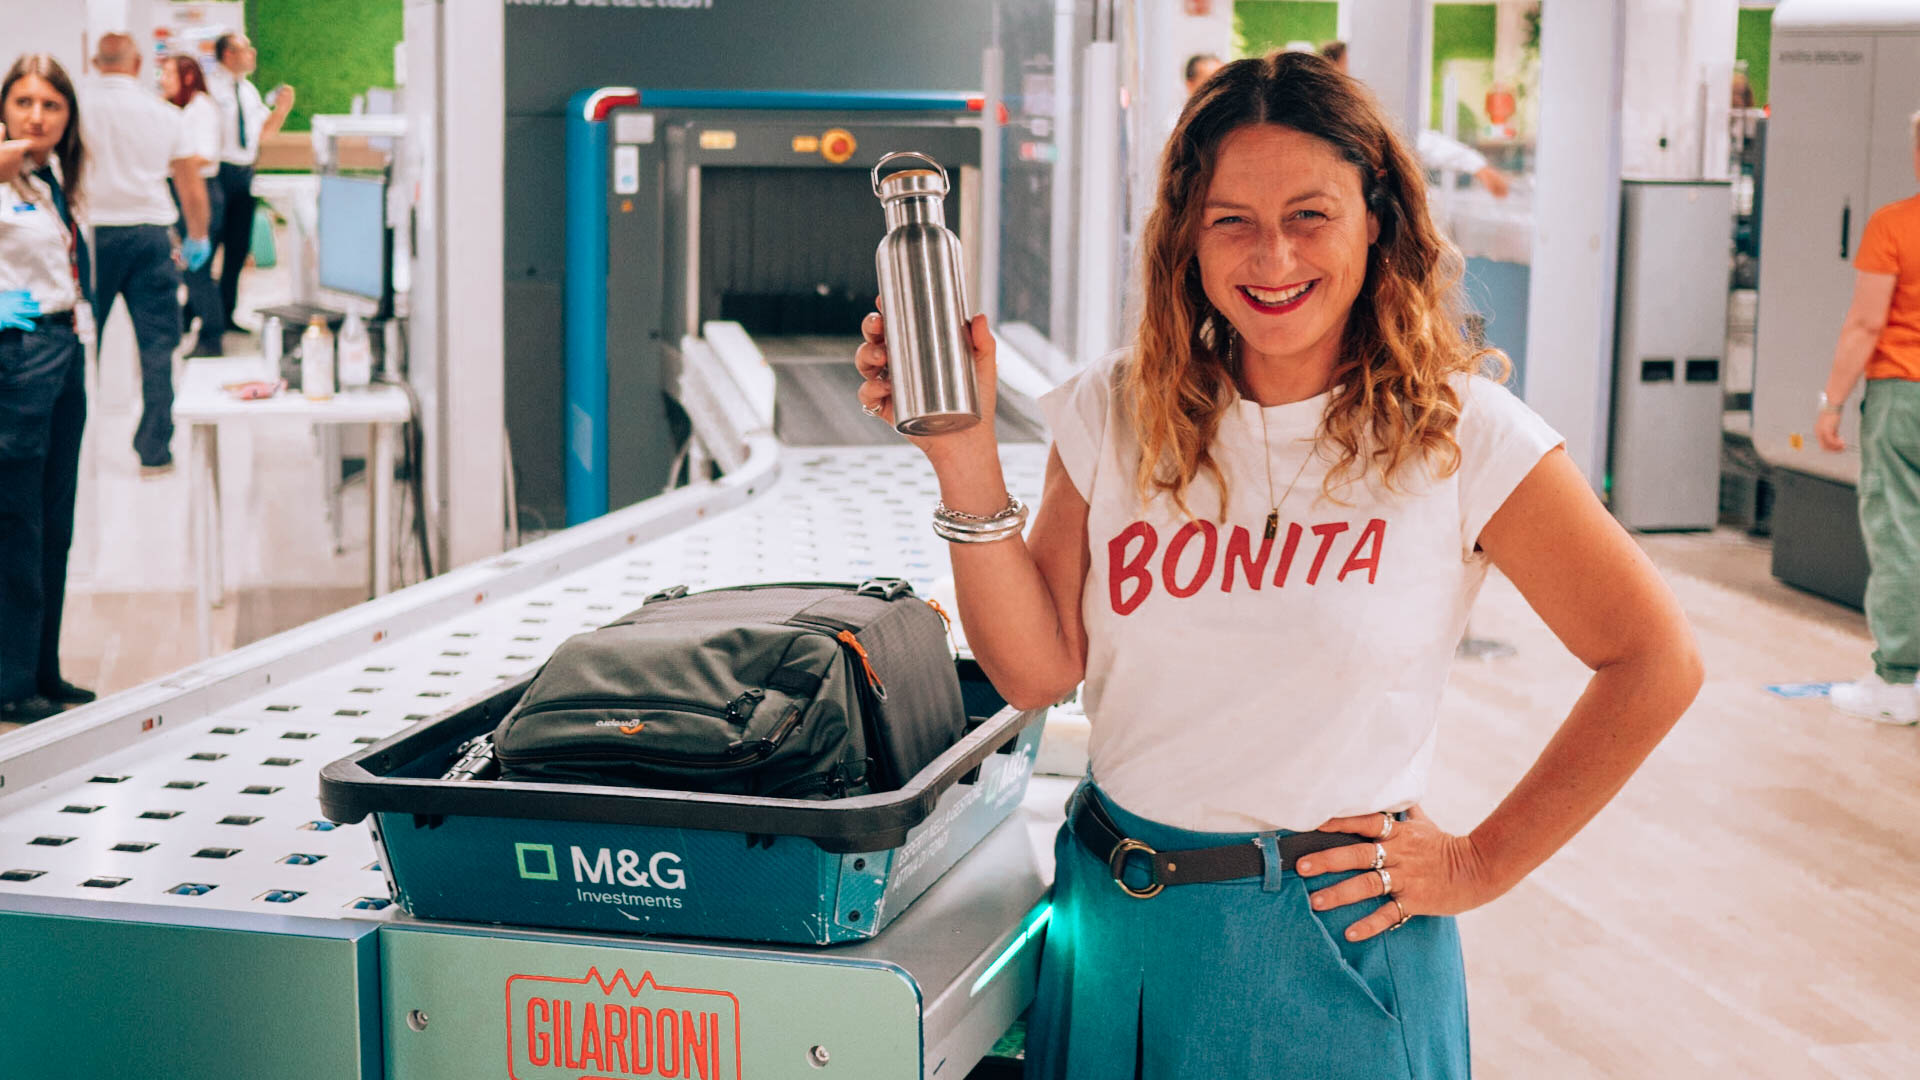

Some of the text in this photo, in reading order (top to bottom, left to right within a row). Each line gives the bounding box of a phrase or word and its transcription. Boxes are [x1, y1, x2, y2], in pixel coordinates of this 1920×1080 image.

[1108, 518, 1387, 616] BONITA
[570, 845, 687, 889] M&G
[577, 888, 683, 909] Investments
[527, 997, 720, 1080] GILARDONI
